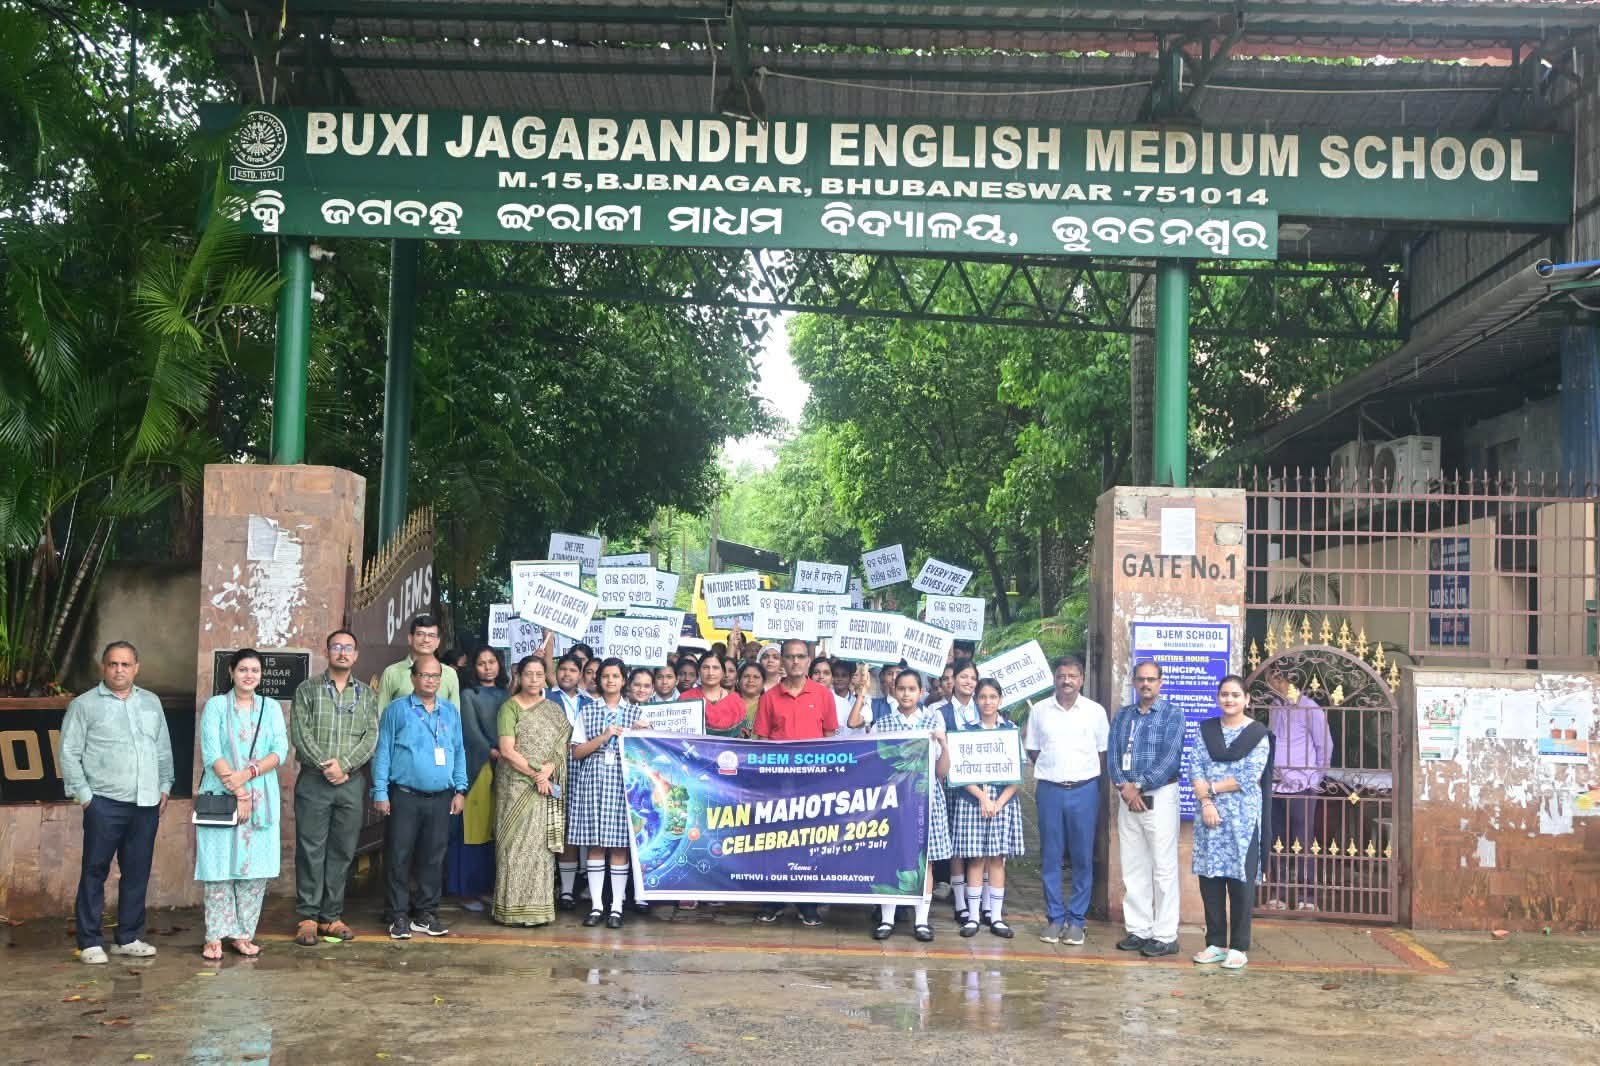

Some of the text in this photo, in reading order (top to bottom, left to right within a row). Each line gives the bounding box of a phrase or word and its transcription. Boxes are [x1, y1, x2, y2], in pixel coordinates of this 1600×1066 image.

[306, 112, 429, 157] BUXI
[445, 115, 808, 165] JAGABANDHU
[830, 122, 1061, 171] ENGLISH
[1085, 127, 1299, 177] MEDIUM
[1319, 135, 1539, 183] SCHOOL
[820, 177, 1113, 201] BHUBANESWAR
[321, 198, 463, 235] ଜଗବନ୍ଧୁ
[497, 203, 642, 232] ଇଂରାଜୀ
[925, 564, 967, 585] EVERY TREE
[1122, 553, 1182, 579] GATE
[535, 585, 562, 607] PLANT
[706, 578, 757, 594] NATURE NEEDS
[920, 577, 958, 596] GIVES LIFE
[386, 563, 433, 646] BJEMS
[716, 594, 750, 608] OUR CARE
[533, 602, 580, 630] LIVE CLEAN
[849, 619, 870, 633] GREEN
[840, 636, 863, 650] BETTER
[863, 637, 898, 653] TOMORROW
[1156, 629, 1224, 641] BJEM SCHOOL
[906, 645, 920, 660] THE
[920, 648, 943, 668] EARTH
[1161, 665, 1208, 674] RINCIPAL
[747, 752, 857, 765] BJEM SCHOOL
[759, 766, 827, 774] BHUBANESWAR
[706, 784, 899, 830] VAN MAHOTSAVA
[722, 818, 890, 856] CELEBRATION 2026
[821, 845, 841, 856] July
[842, 844, 853, 852] to
[868, 840, 888, 850] July
[730, 873, 764, 881] PRITHVI
[770, 873, 787, 881] OUR
[790, 874, 819, 882] LIVING
[820, 874, 875, 882] LABORATORY
